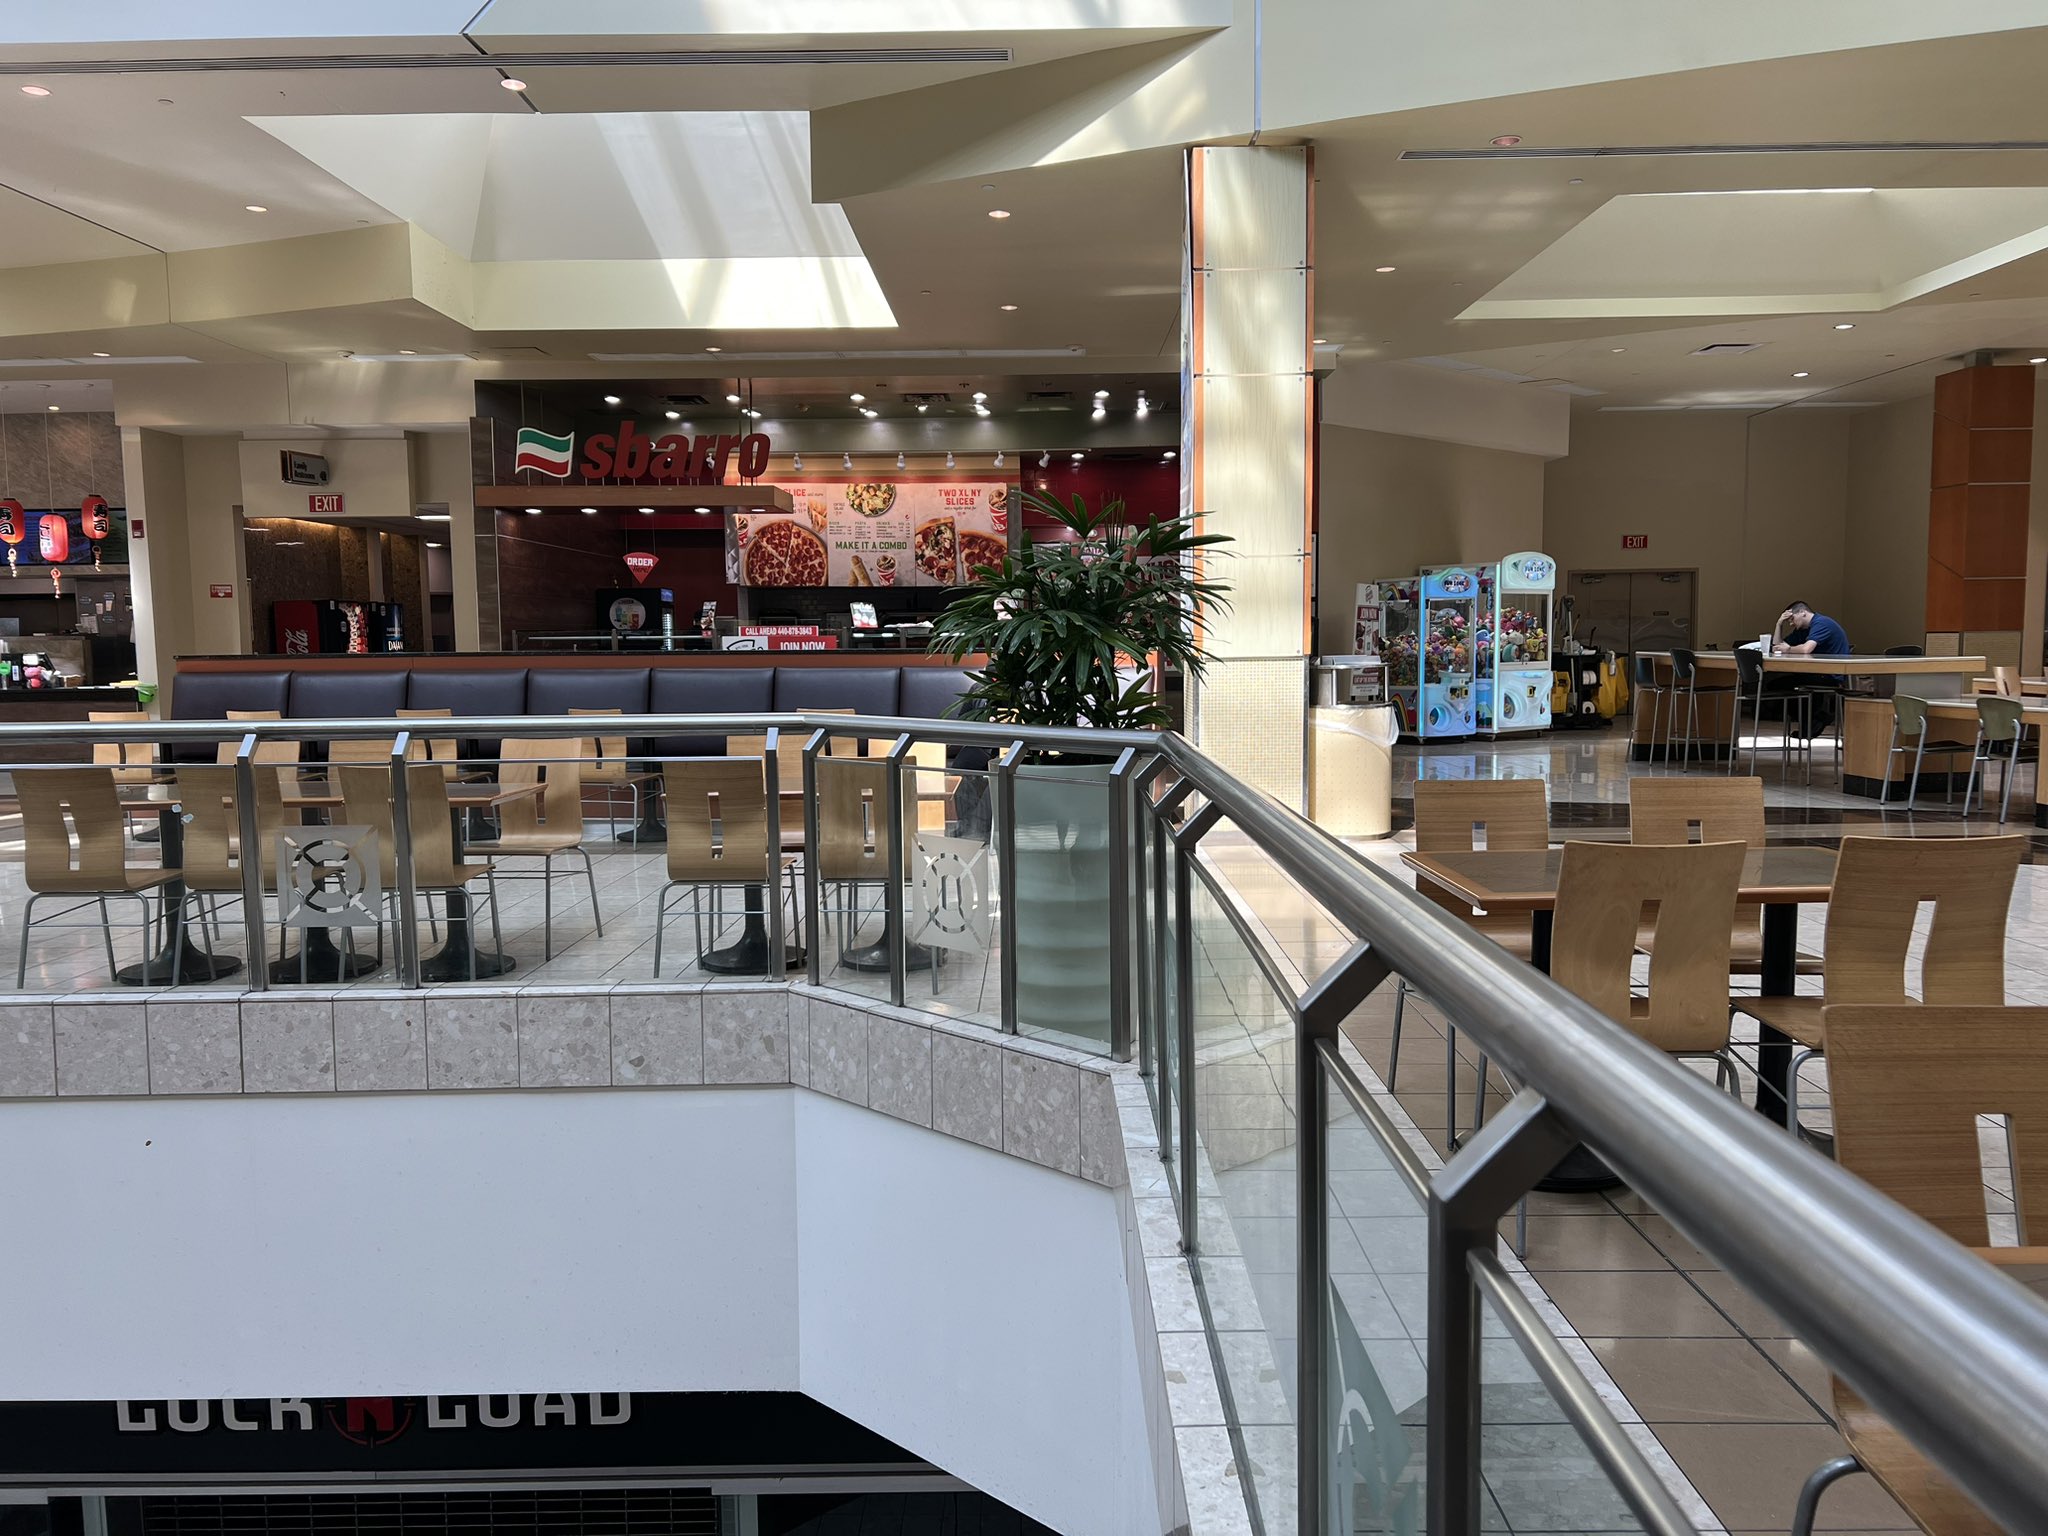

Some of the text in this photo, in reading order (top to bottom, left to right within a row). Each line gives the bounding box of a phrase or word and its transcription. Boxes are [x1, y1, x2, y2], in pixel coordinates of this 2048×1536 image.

[579, 420, 771, 479] sbarro
[938, 489, 981, 497] TWO XL NY
[315, 496, 339, 512] EXIT
[835, 541, 908, 550] MAKE IT A COMBO
[1626, 535, 1646, 549] EXIT
[626, 557, 654, 567] ORDER
[745, 627, 758, 636] CALL
[759, 627, 777, 636] AHEAD
[803, 641, 826, 650] NOW
